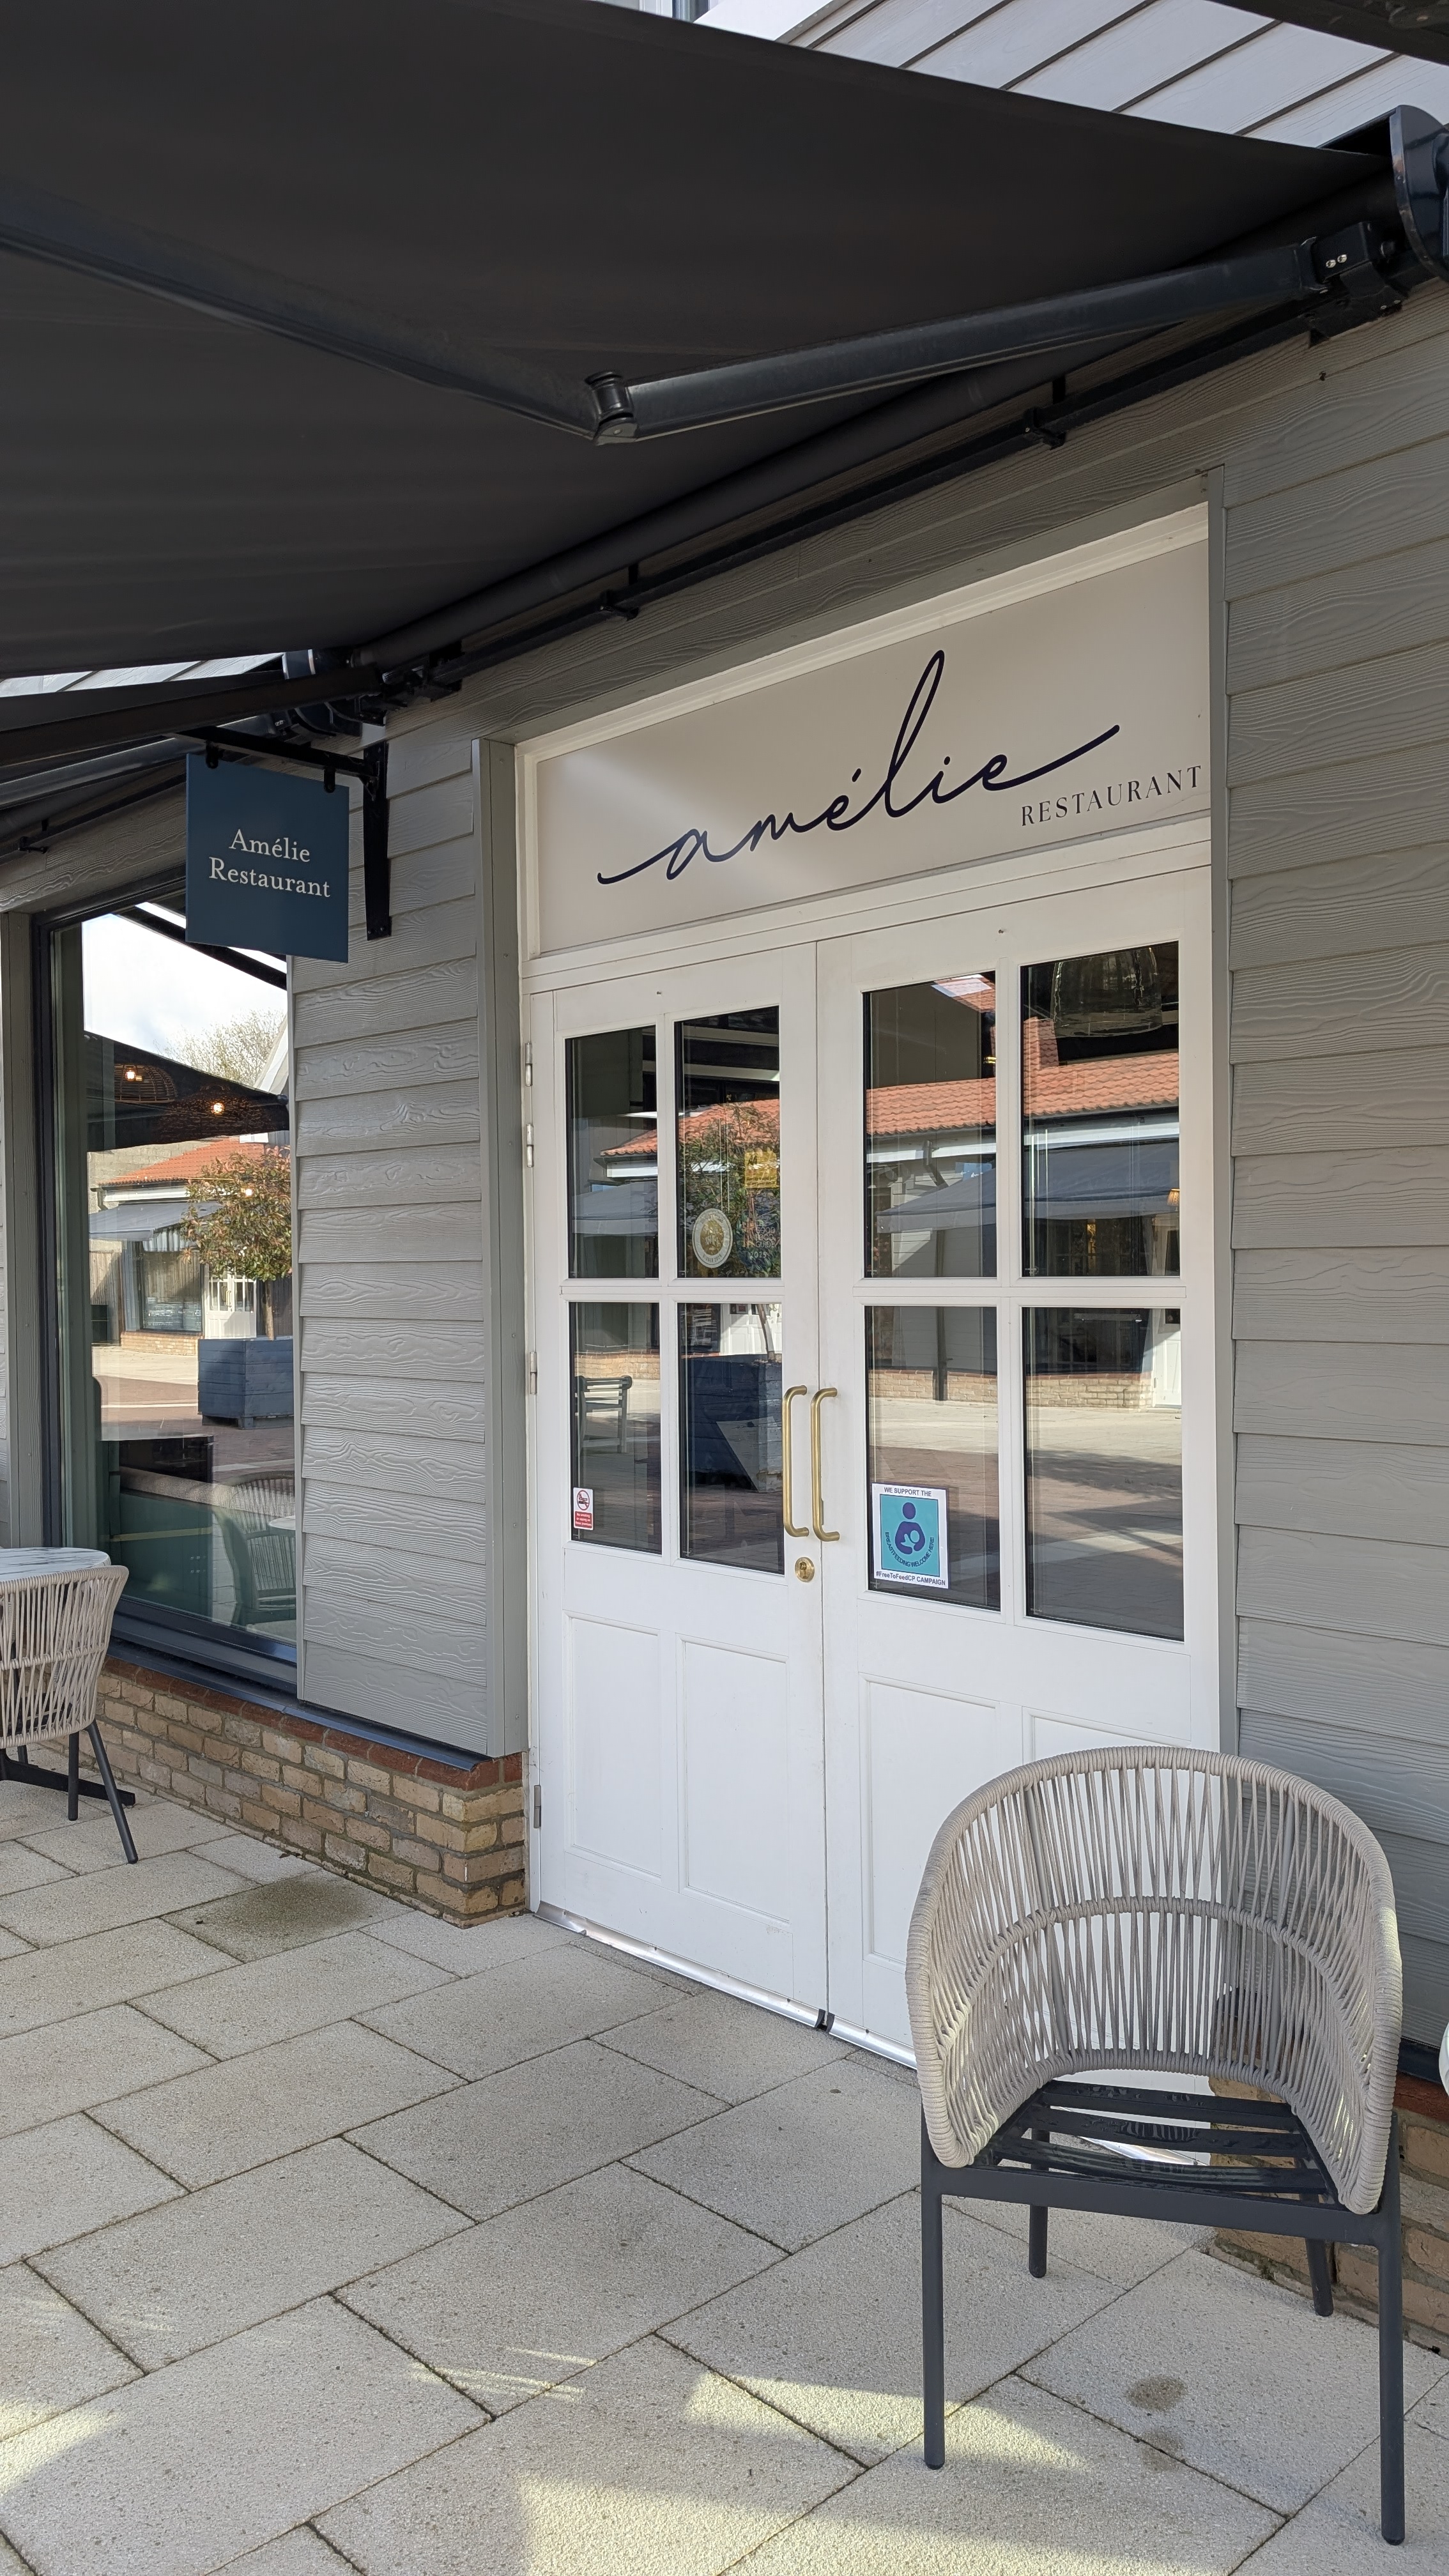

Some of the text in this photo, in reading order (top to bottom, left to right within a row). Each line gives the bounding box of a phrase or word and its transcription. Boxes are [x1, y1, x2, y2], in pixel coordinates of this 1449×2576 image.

[597, 650, 1119, 884] amélie
[1022, 765, 1201, 827] RESTAURANT
[229, 829, 310, 862] Amélie
[209, 857, 331, 898] Restaurant
[910, 1553, 931, 1567] WELCOME
[917, 1576, 946, 1586] CAMPAIGN
